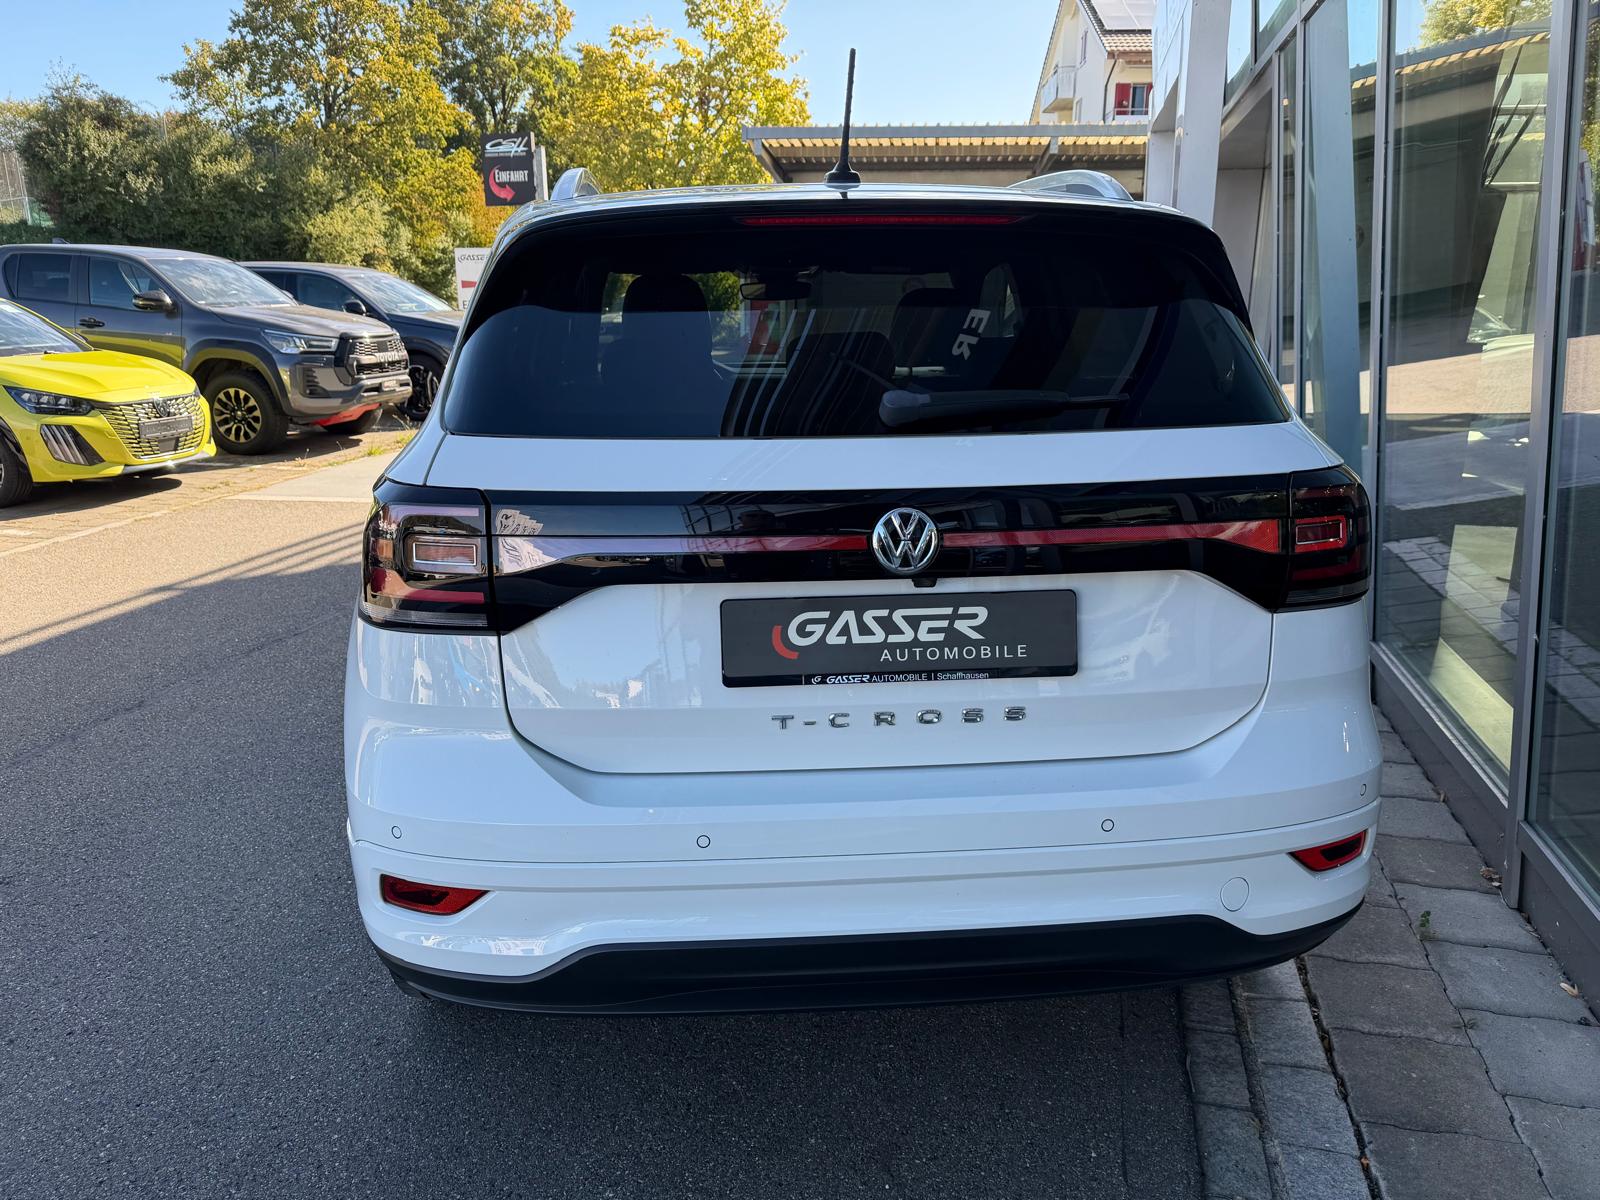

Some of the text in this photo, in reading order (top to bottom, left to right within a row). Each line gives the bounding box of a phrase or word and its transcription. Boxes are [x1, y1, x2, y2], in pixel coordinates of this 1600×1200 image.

[494, 169, 529, 183] EINFAHRT
[376, 351, 400, 362] TOYOTA
[787, 606, 988, 647] GASSER
[880, 644, 1027, 662] AUTOMOBILE
[826, 673, 870, 684] GASSER
[871, 672, 928, 683] AUTOMOBILE
[936, 671, 990, 681] Schaffhausen
[771, 706, 1027, 730] T-CROSS
